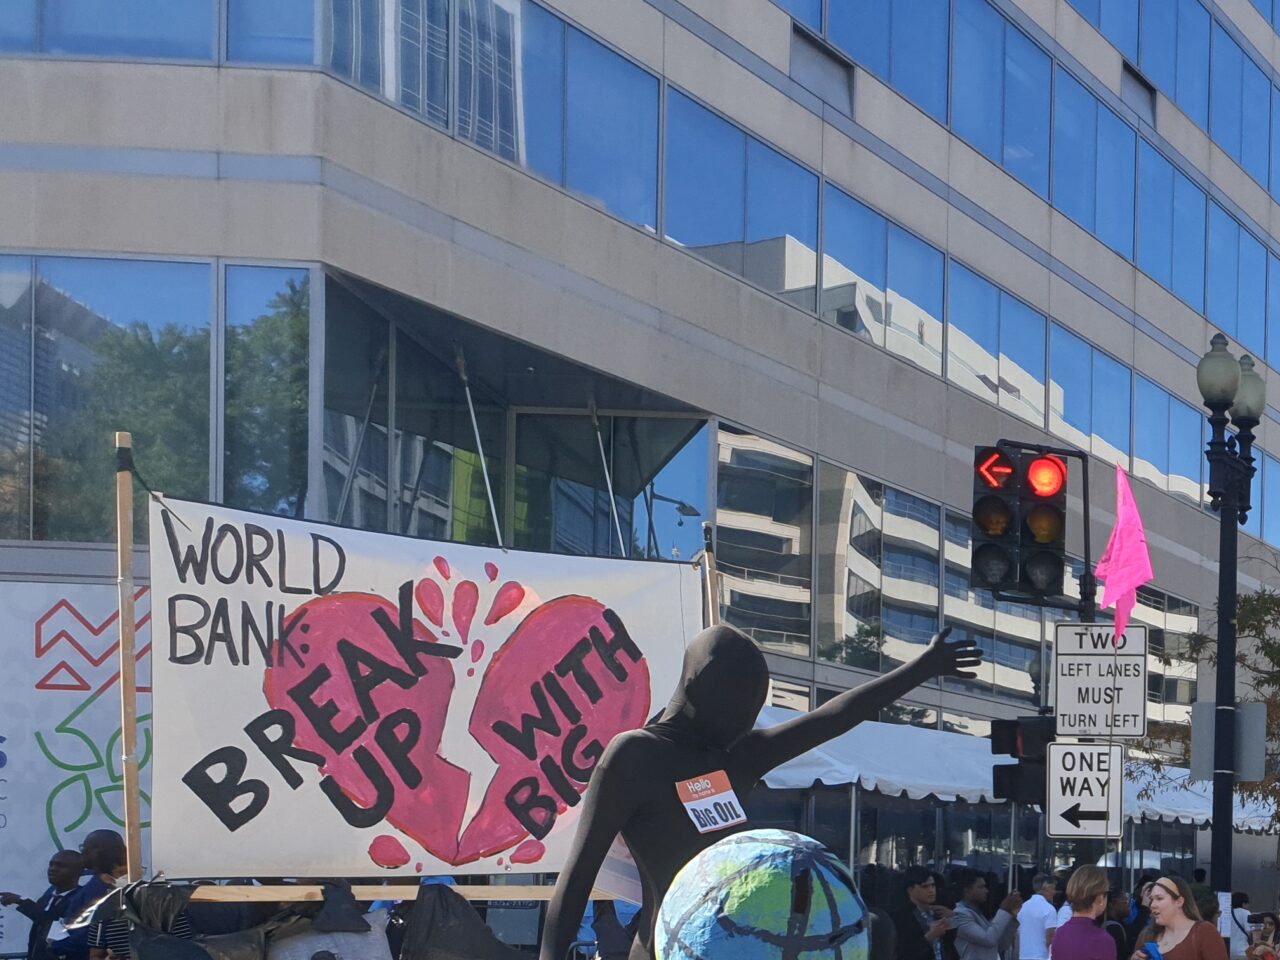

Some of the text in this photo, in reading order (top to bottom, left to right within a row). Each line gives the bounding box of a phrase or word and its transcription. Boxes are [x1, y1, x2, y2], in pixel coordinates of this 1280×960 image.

[161, 509, 346, 596] WORLD
[1074, 632, 1127, 650] TWO
[1060, 663, 1141, 677] LEFT LANES
[490, 608, 644, 763] WITH
[1078, 687, 1123, 704] MUST
[181, 580, 464, 832] BREAK
[1060, 714, 1140, 728] TURN LEFT
[320, 708, 427, 830] UP
[1061, 752, 1109, 772] ONE
[504, 724, 605, 841] BIG
[686, 778, 712, 792] Hello
[1060, 777, 1110, 797] WAY
[690, 800, 741, 828] BIG OIL
